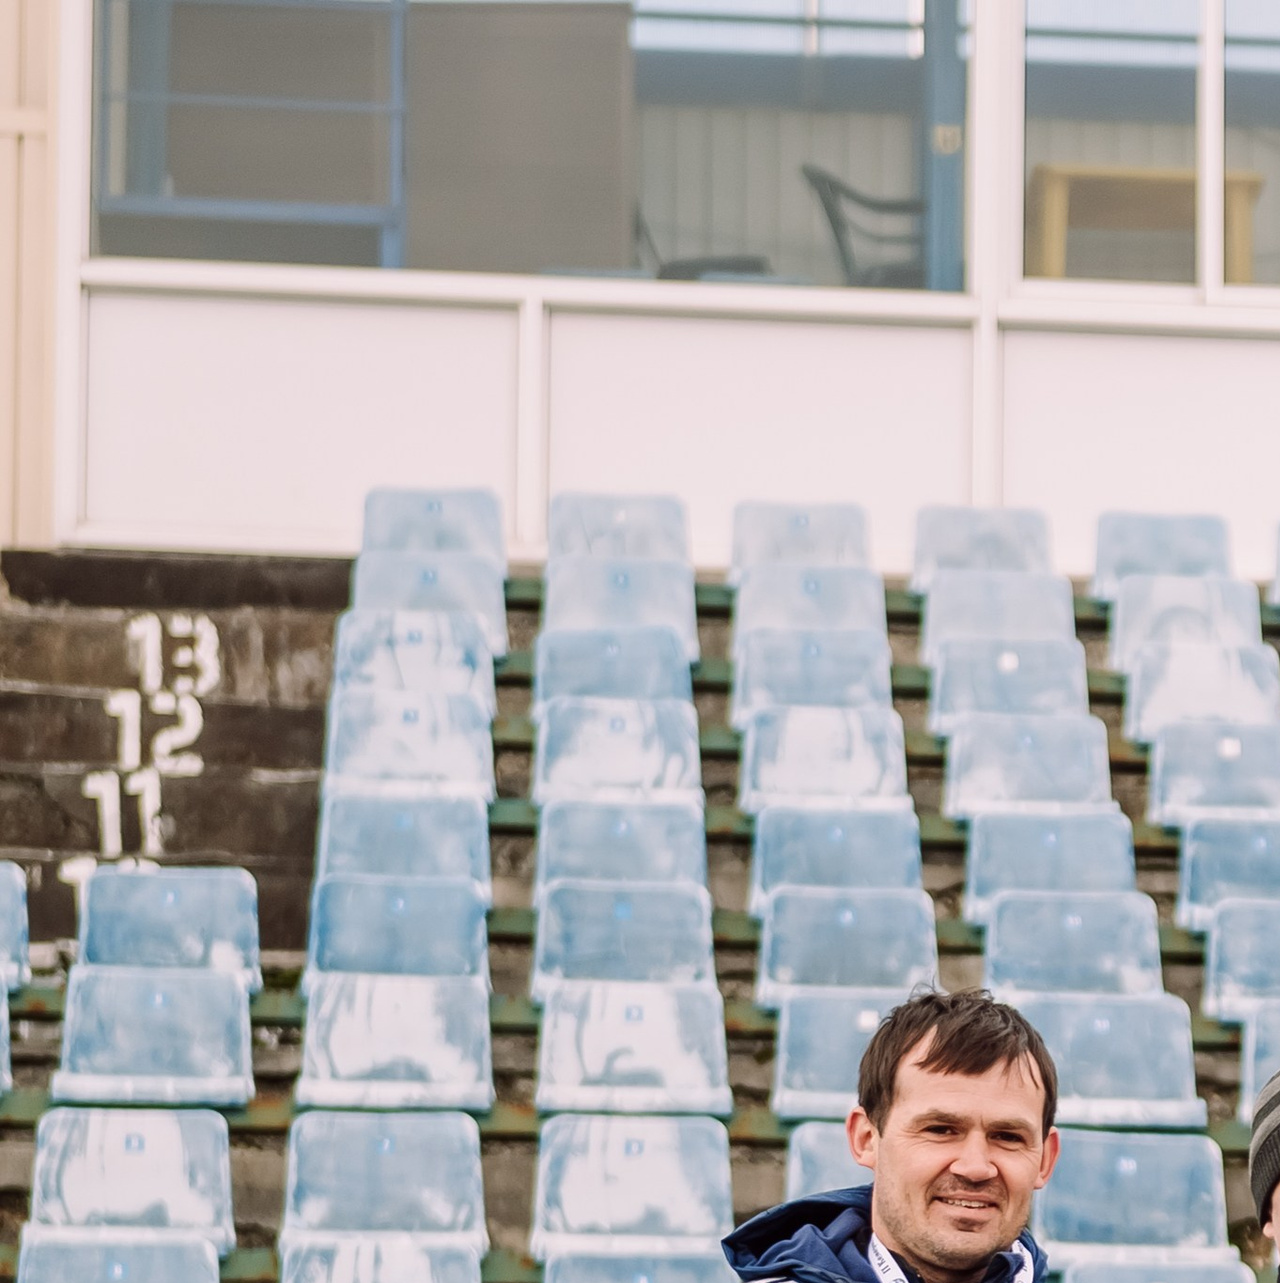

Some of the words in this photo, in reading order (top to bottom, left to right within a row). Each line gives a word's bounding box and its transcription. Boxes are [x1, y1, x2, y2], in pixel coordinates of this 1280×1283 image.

[126, 612, 220, 696] 13
[104, 688, 204, 777] 12
[81, 766, 165, 859] 11
